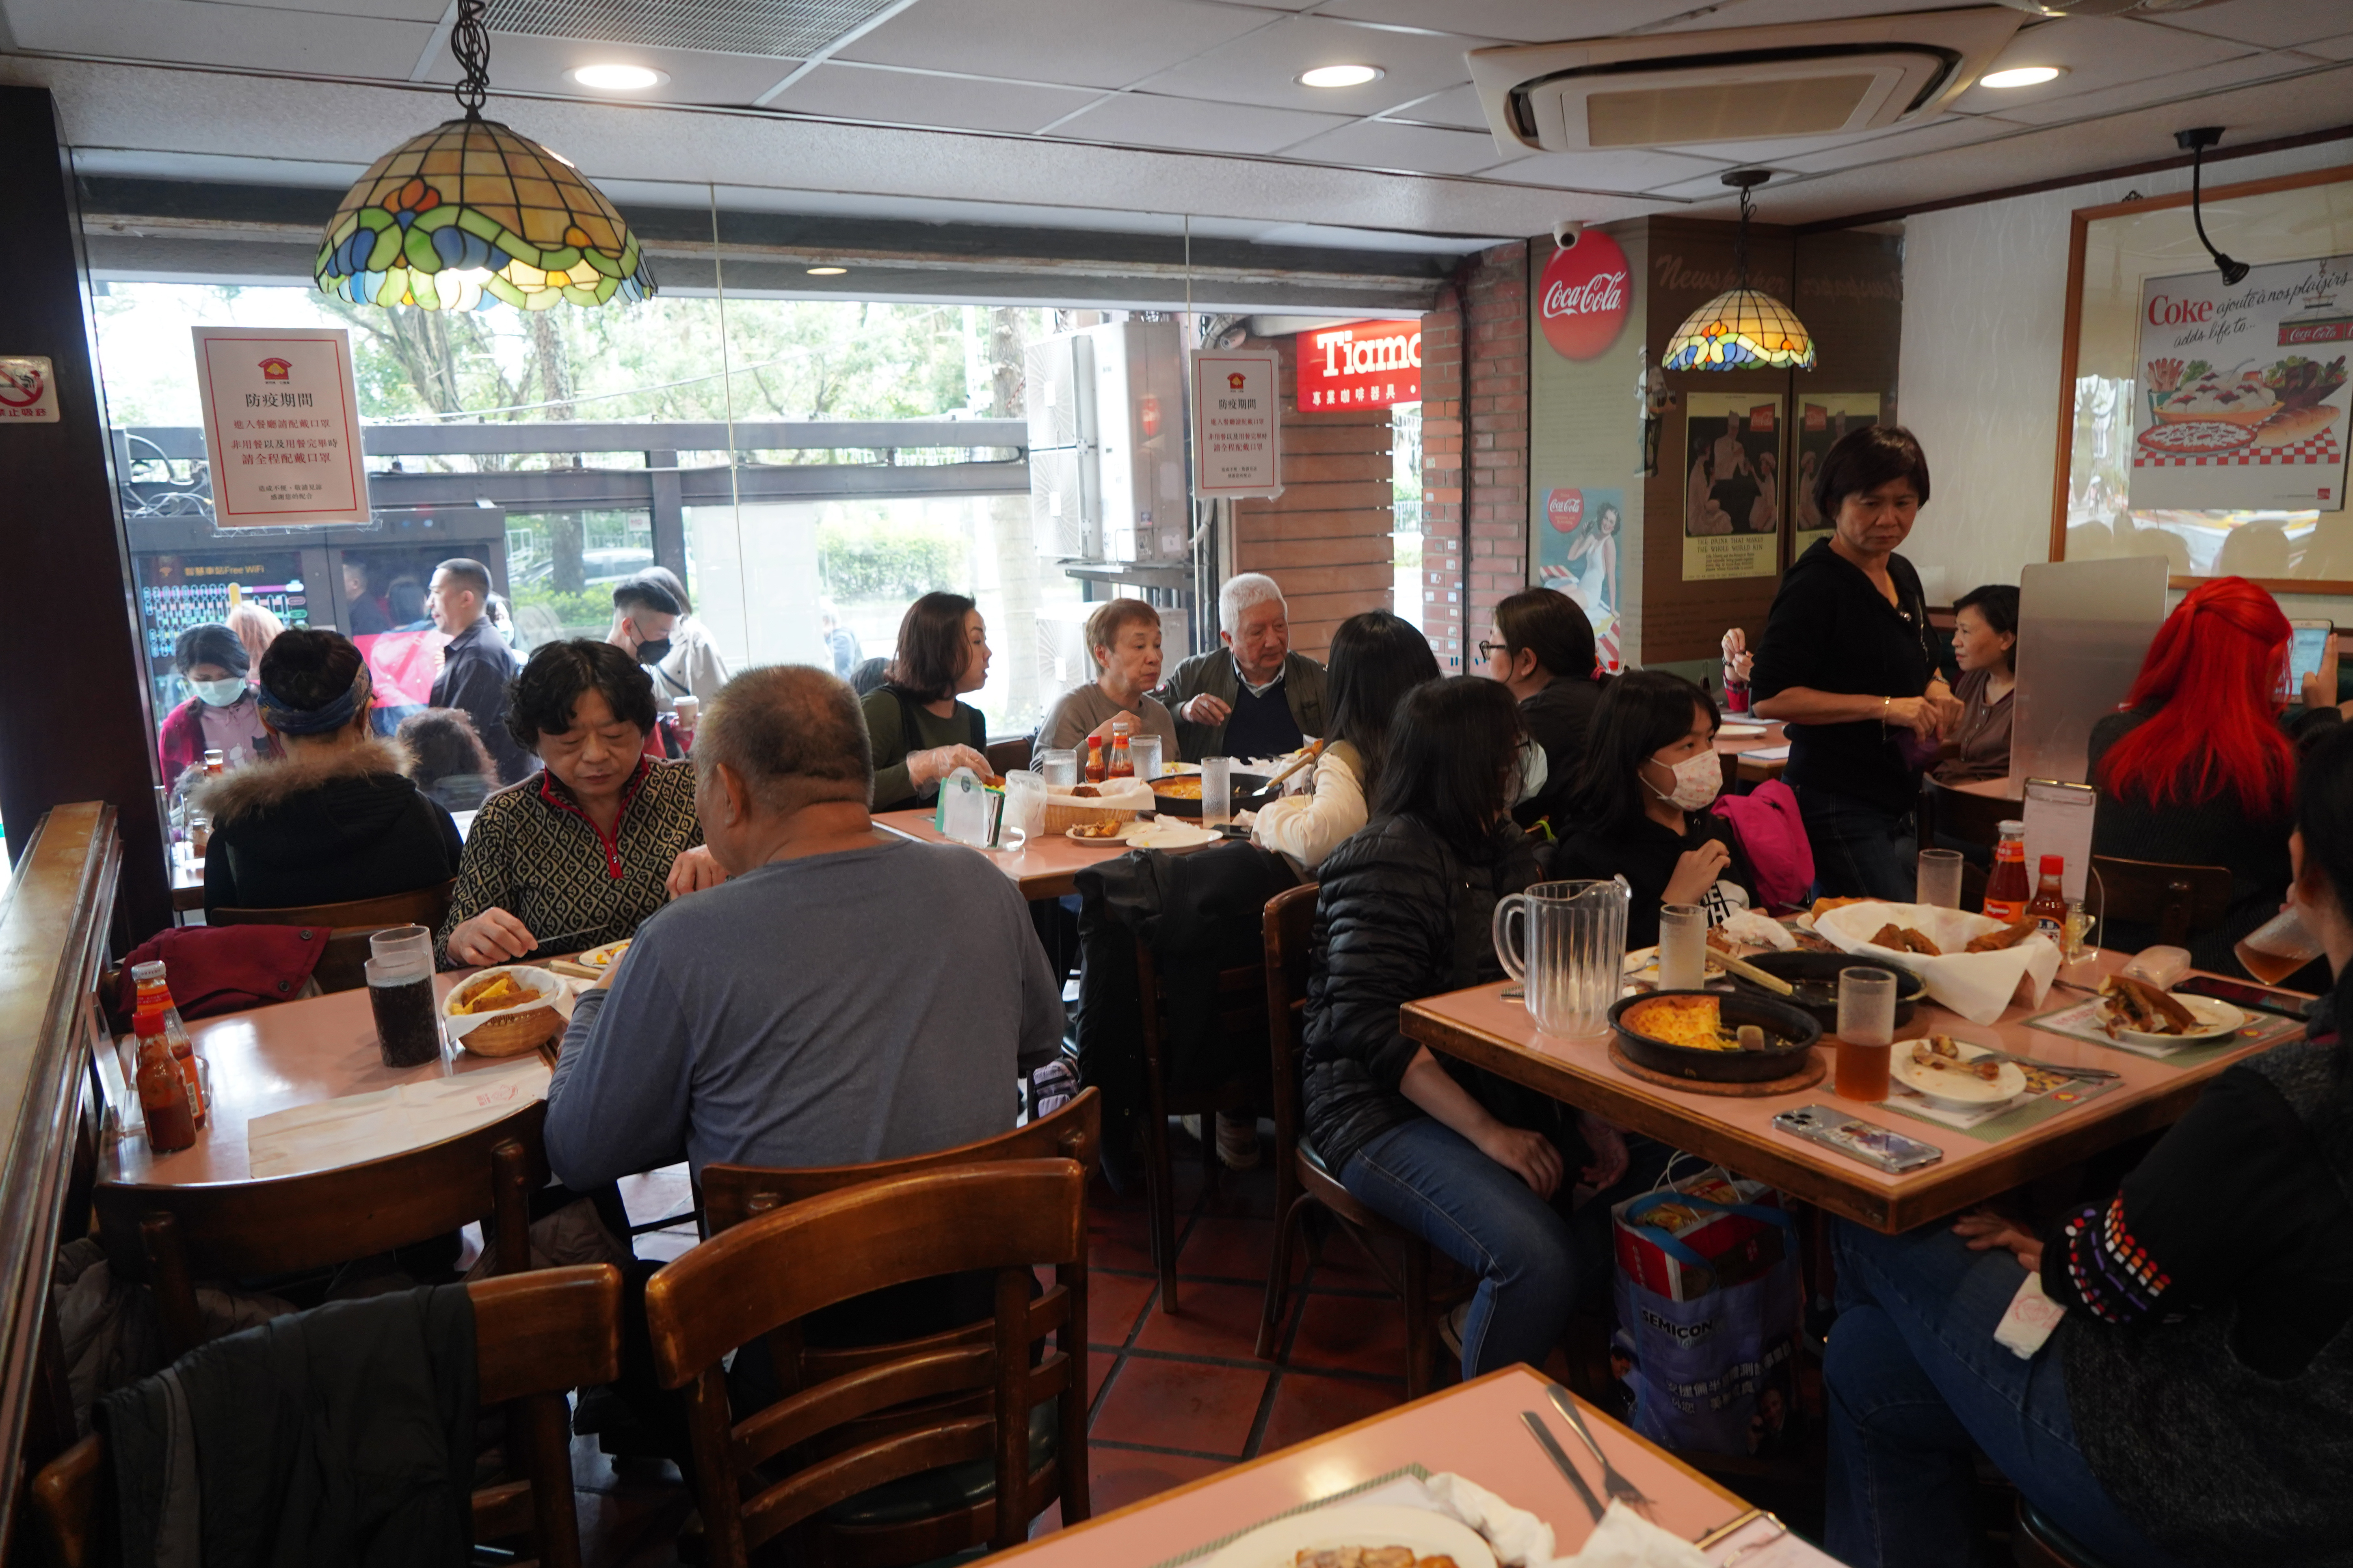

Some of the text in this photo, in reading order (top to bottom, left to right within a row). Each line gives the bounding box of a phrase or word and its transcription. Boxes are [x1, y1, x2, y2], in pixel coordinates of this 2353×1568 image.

[1543, 271, 1626, 298] Coca-Cola
[2148, 295, 2213, 326] Coke
[2208, 321, 2232, 344] life
[245, 393, 314, 408] 防疫期間
[1219, 398, 1256, 410] 防疫期間
[1313, 384, 1395, 406] 專業咖啡器具
[234, 419, 331, 430] 進入餐廳請配戴口罩
[231, 439, 338, 449] 非用餐以及用餐完畢時
[242, 453, 331, 465] 請全程配戴口罩
[1642, 1310, 1713, 1339] SEMICON
